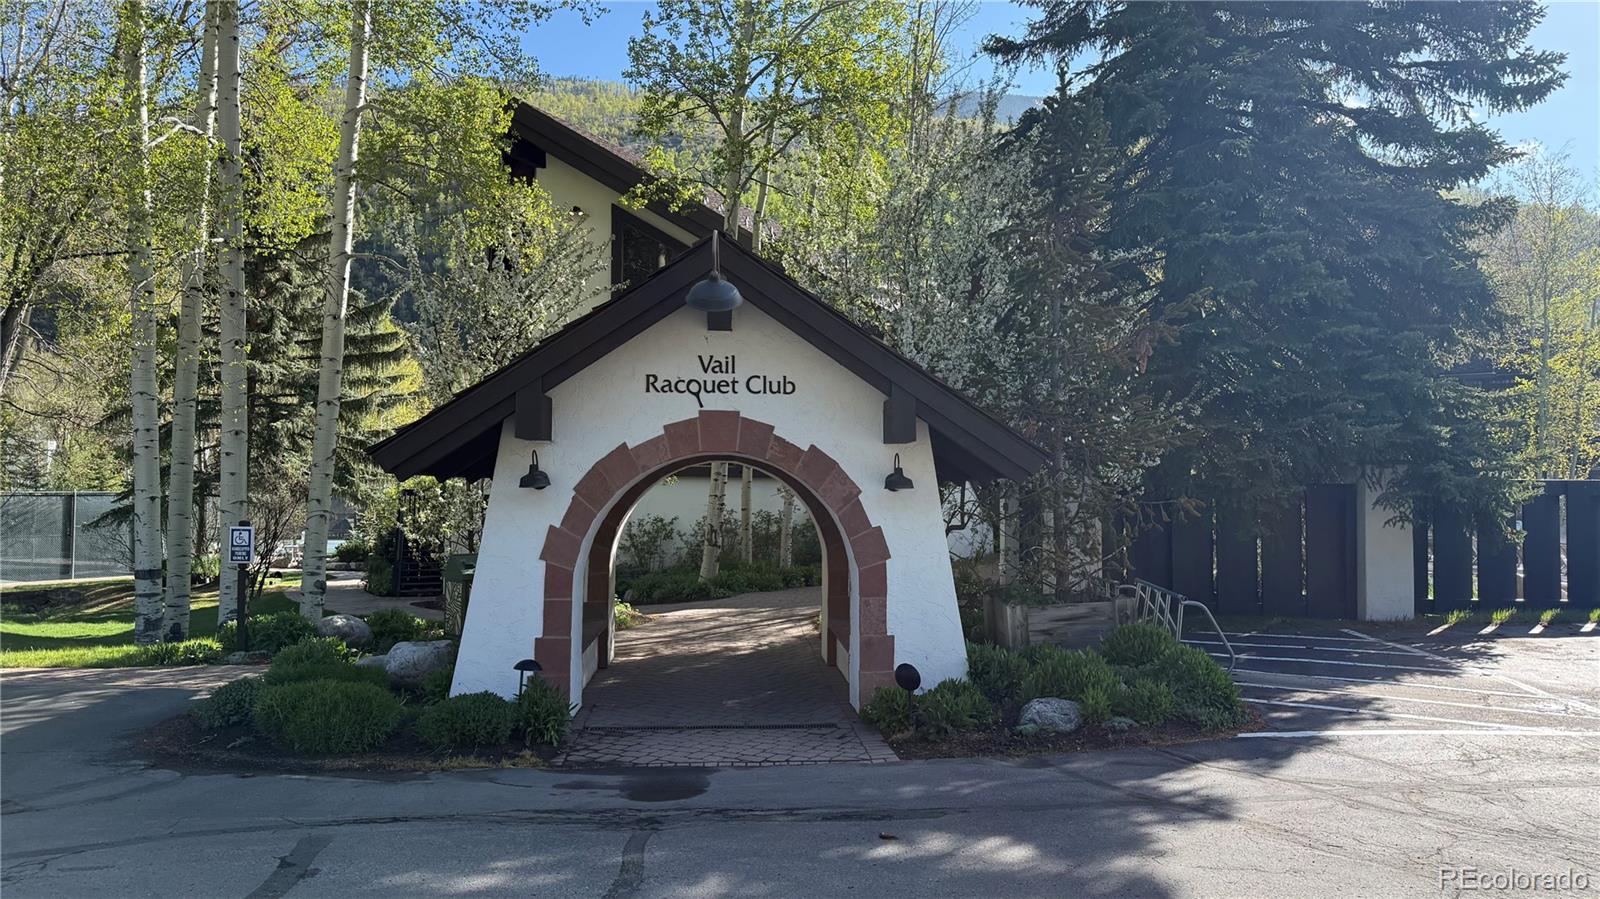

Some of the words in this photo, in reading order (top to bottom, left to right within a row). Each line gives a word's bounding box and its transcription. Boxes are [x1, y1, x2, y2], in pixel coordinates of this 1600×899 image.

[697, 354, 736, 375] Vail
[645, 373, 739, 408] Racquet
[745, 374, 796, 395] Club
